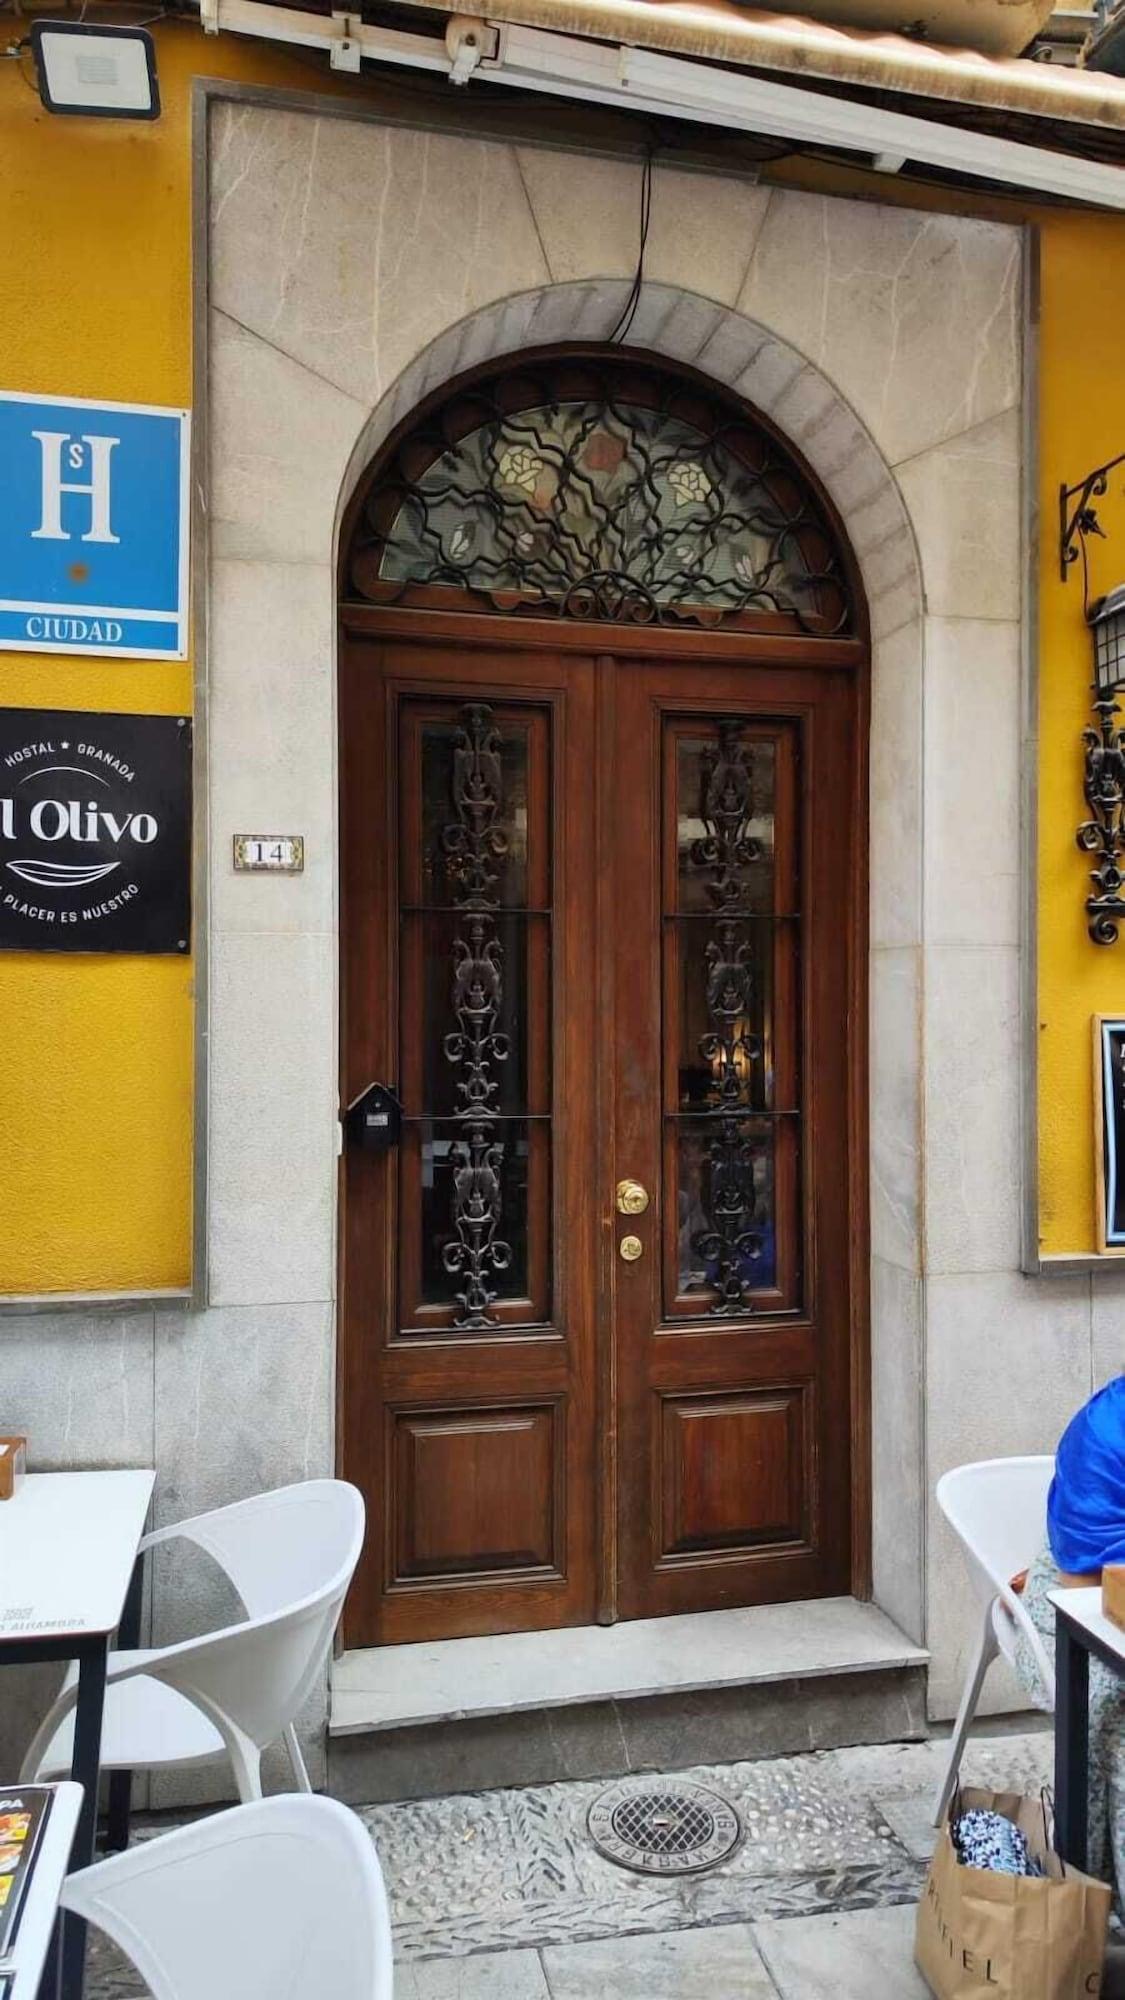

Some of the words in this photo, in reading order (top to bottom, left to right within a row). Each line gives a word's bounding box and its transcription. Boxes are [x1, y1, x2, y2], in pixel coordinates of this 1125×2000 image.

[26, 617, 122, 642] CIUDAD
[4, 742, 55, 768] HOSTAL
[77, 744, 136, 783] GRANADA
[0, 799, 17, 840] l
[30, 799, 158, 843] Olivo
[256, 844, 282, 862] 14
[3, 894, 55, 921] PLACER
[61, 911, 77, 923] ES
[83, 884, 138, 920] NUESTRO
